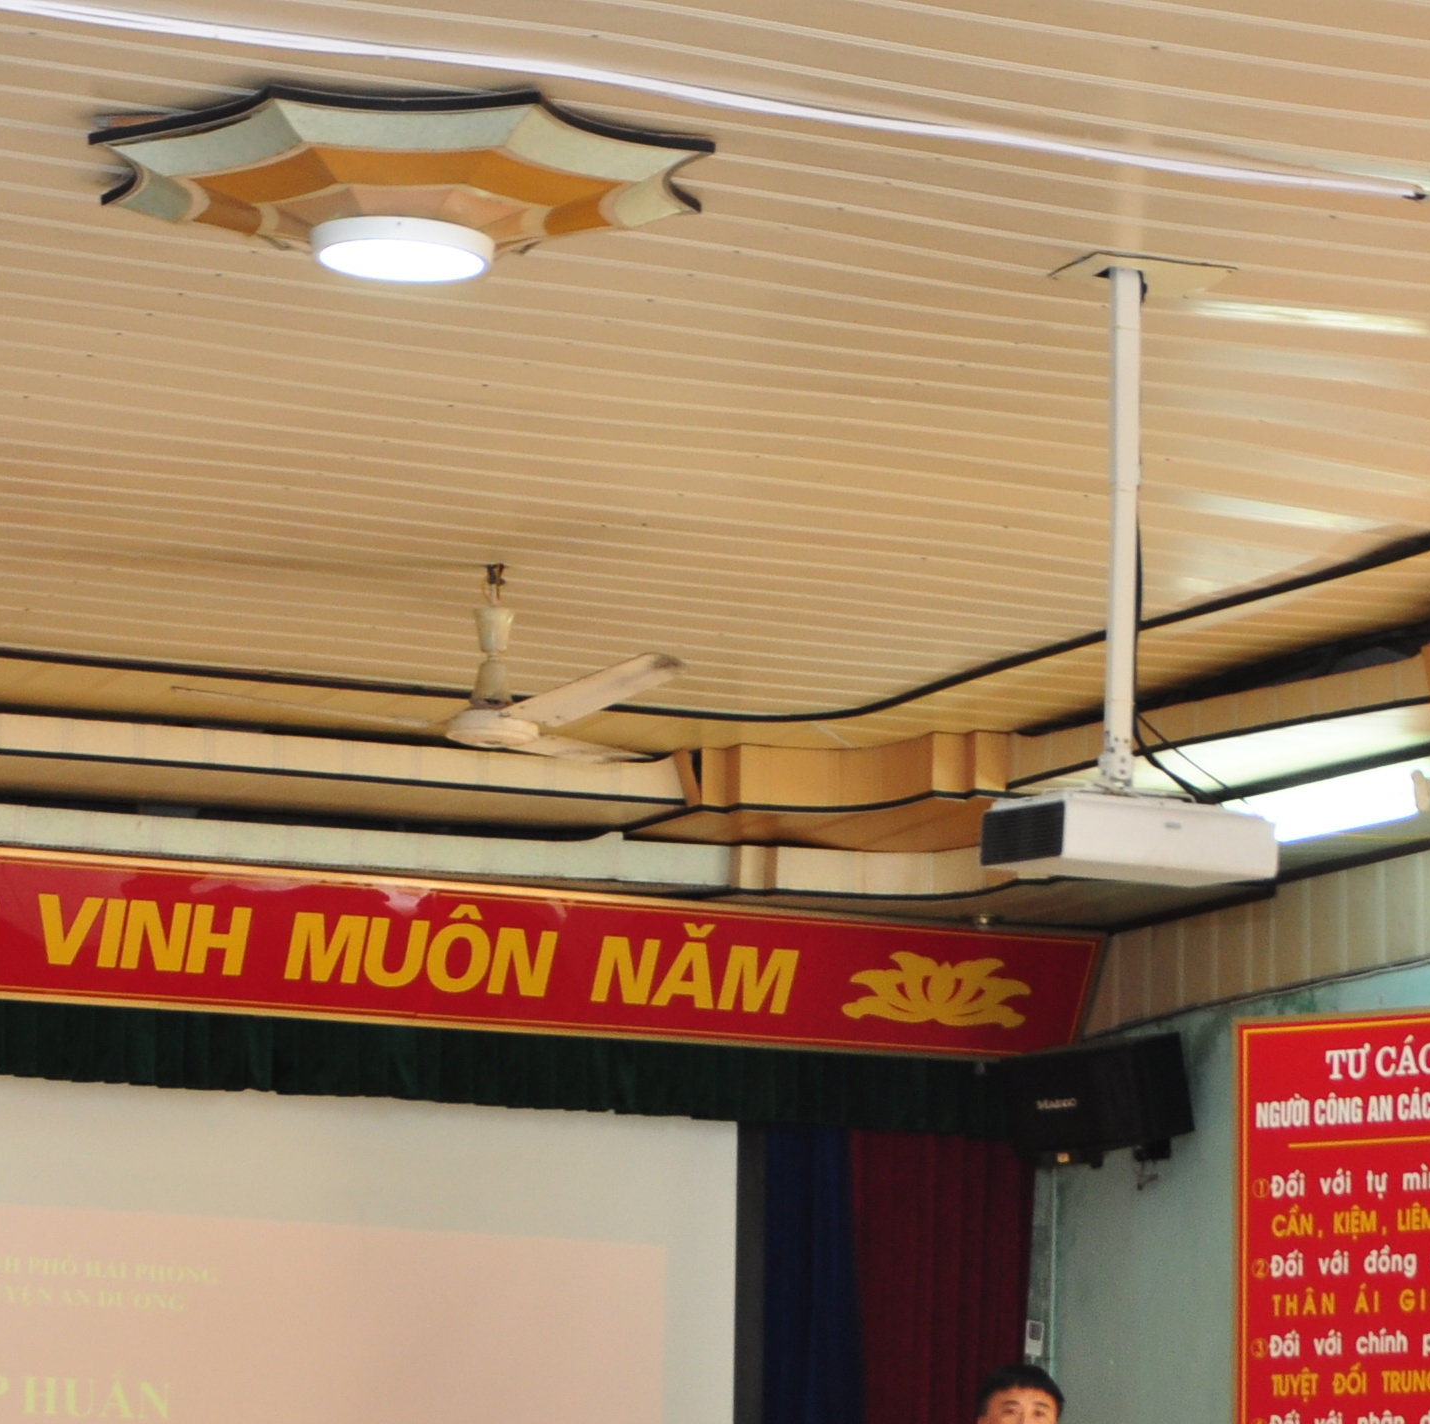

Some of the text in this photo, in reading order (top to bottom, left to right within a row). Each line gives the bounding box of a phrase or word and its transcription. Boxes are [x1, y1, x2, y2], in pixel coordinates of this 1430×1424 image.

[39, 892, 252, 977] VINH
[284, 903, 560, 997] MUÔN
[590, 923, 799, 1017] NĂM
[1326, 1042, 1369, 1080] TƯ
[1255, 1093, 1309, 1128] NGƯỜI
[1314, 1092, 1363, 1126] CÔNG
[1368, 1095, 1392, 1122] AN
[1270, 1170, 1305, 1198] Đối
[1320, 1168, 1351, 1195] với
[1367, 1171, 1388, 1198] tự
[1270, 1250, 1303, 1278] Đối
[1318, 1249, 1348, 1275] với
[1364, 1245, 1417, 1277] đồng
[1272, 1288, 1335, 1316] THÂN
[1355, 1283, 1379, 1313] ÁI
[1269, 1330, 1299, 1357] Đối
[1314, 1329, 1342, 1356] với
[1356, 1328, 1408, 1355] chính
[23, 1369, 171, 1421] HUẤN
[1271, 1367, 1318, 1402] TUYỆT
[1332, 1363, 1367, 1395] ĐỐI
